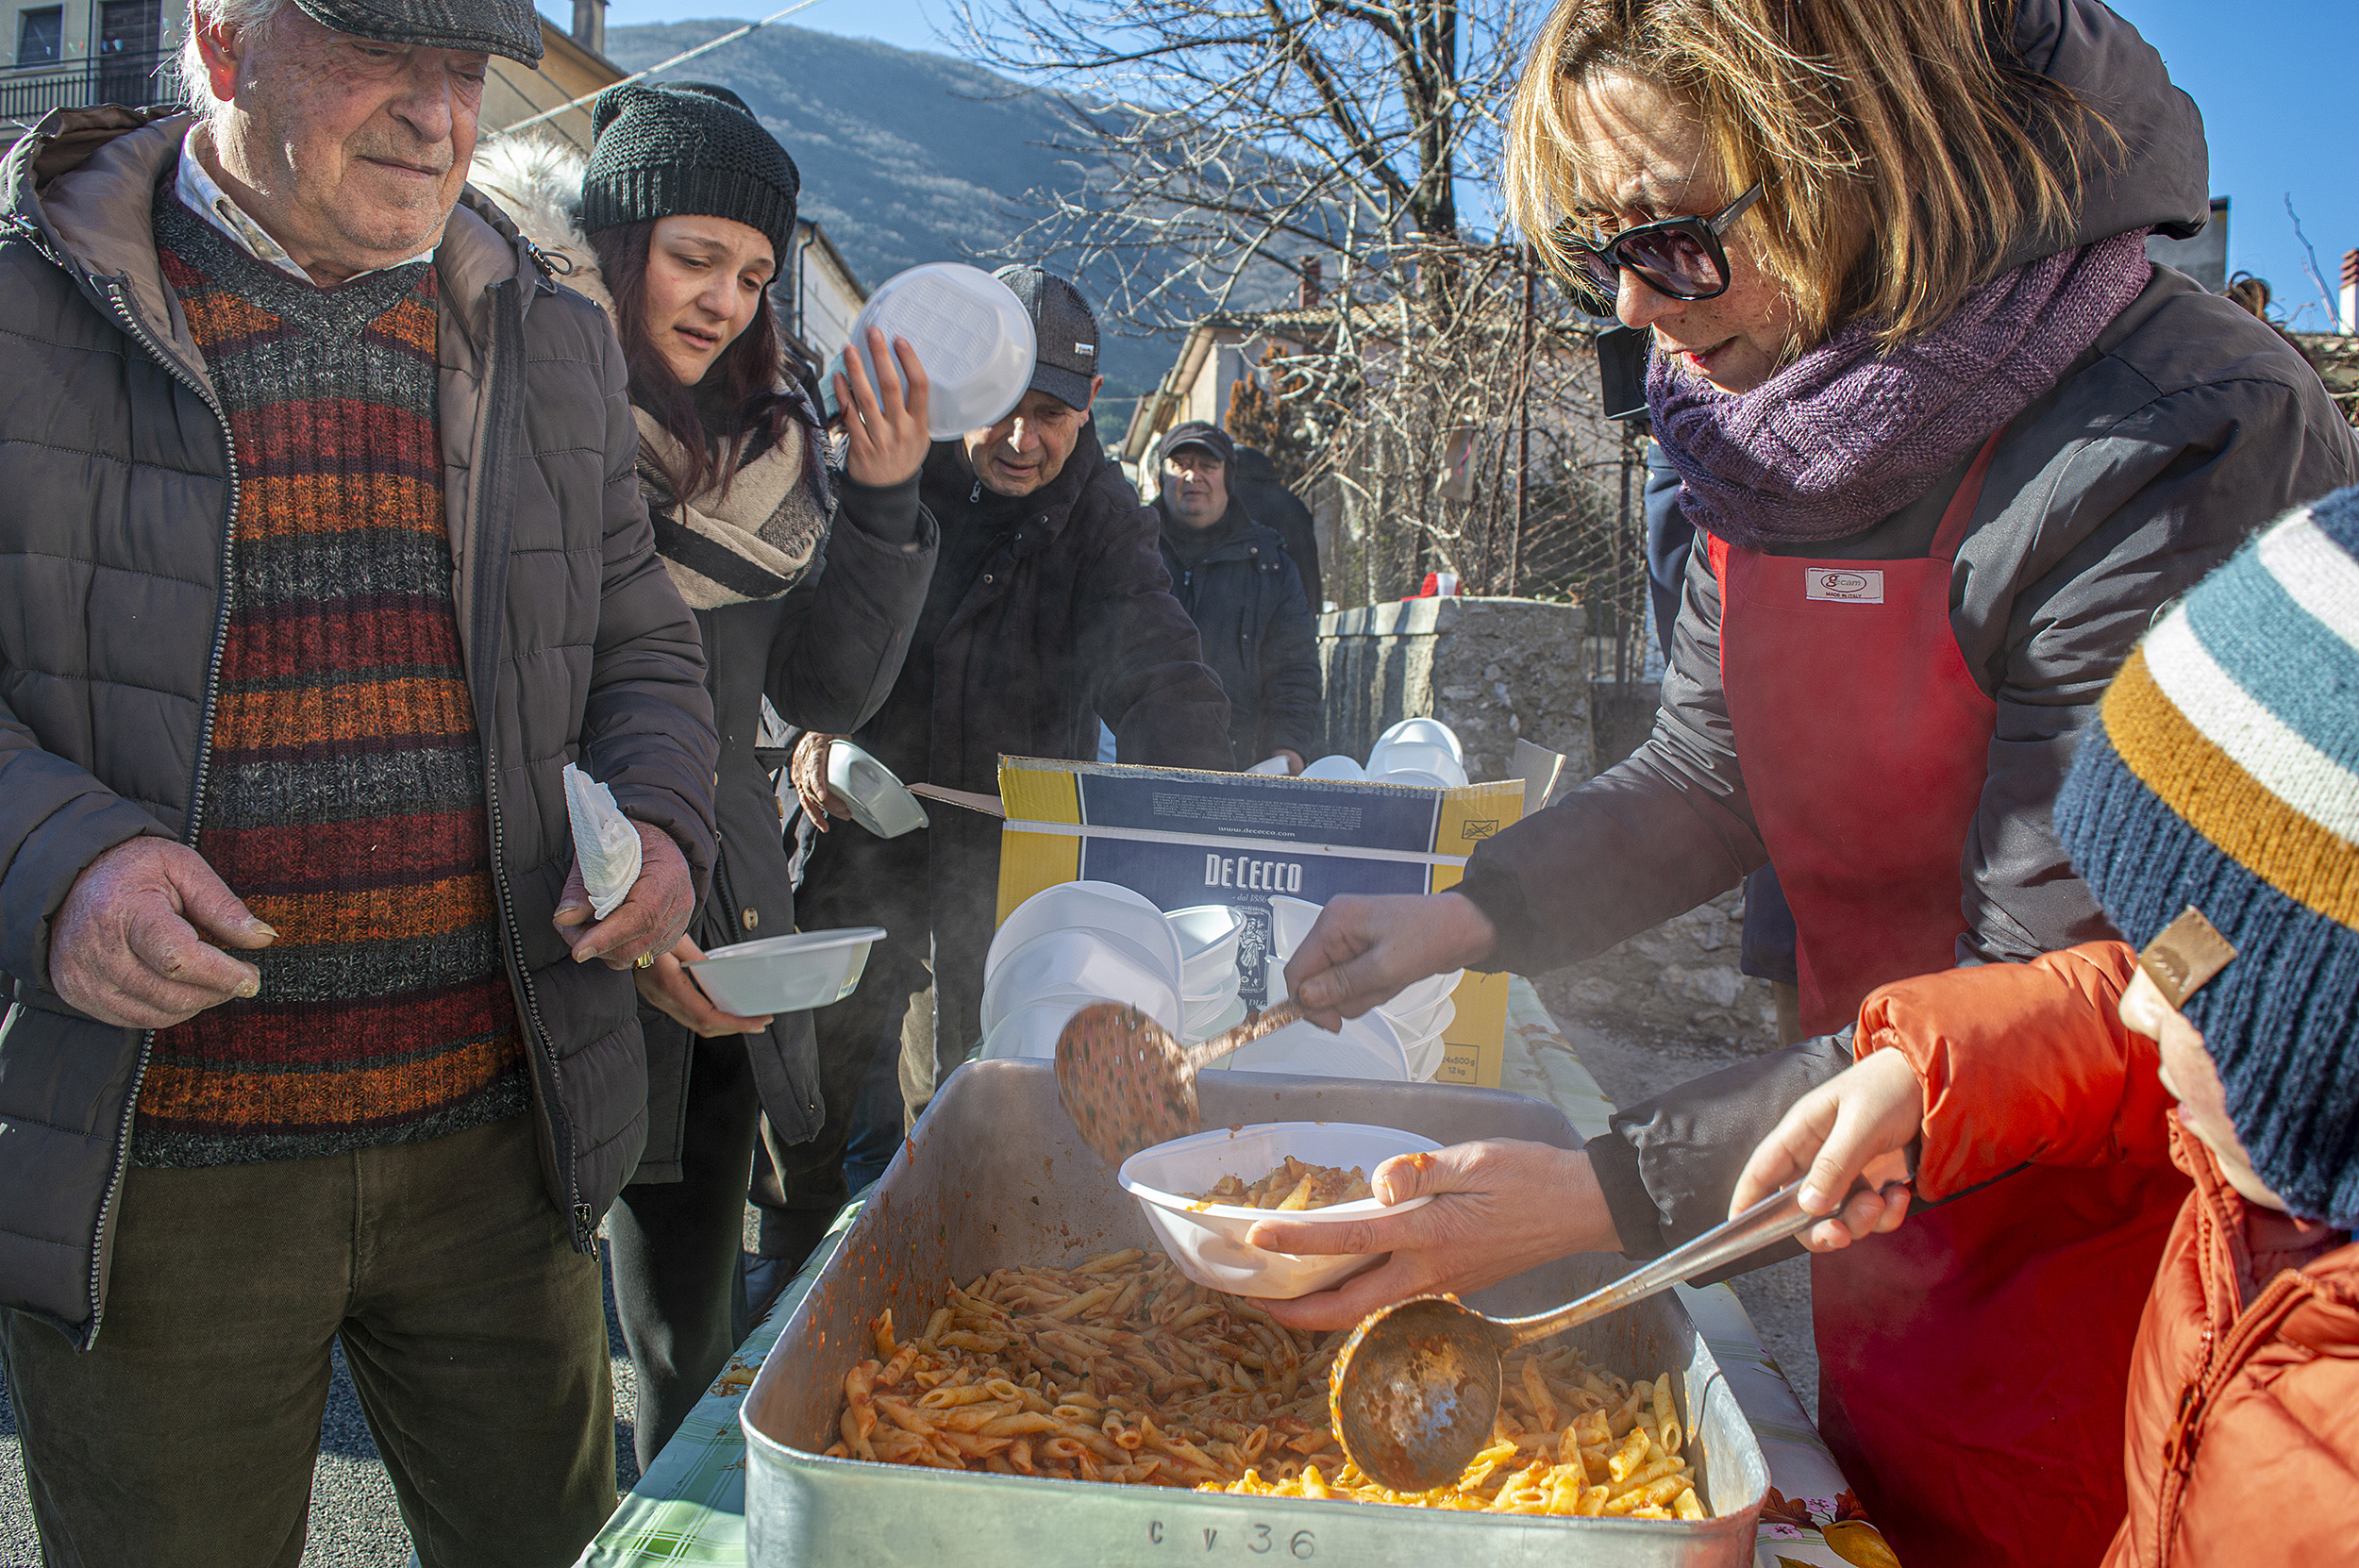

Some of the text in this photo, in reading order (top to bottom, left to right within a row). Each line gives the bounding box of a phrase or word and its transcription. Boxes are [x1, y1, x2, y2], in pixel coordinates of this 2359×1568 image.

[1218, 826, 1296, 837] www.dececco.com
[1237, 893, 1266, 903] dal 1886
